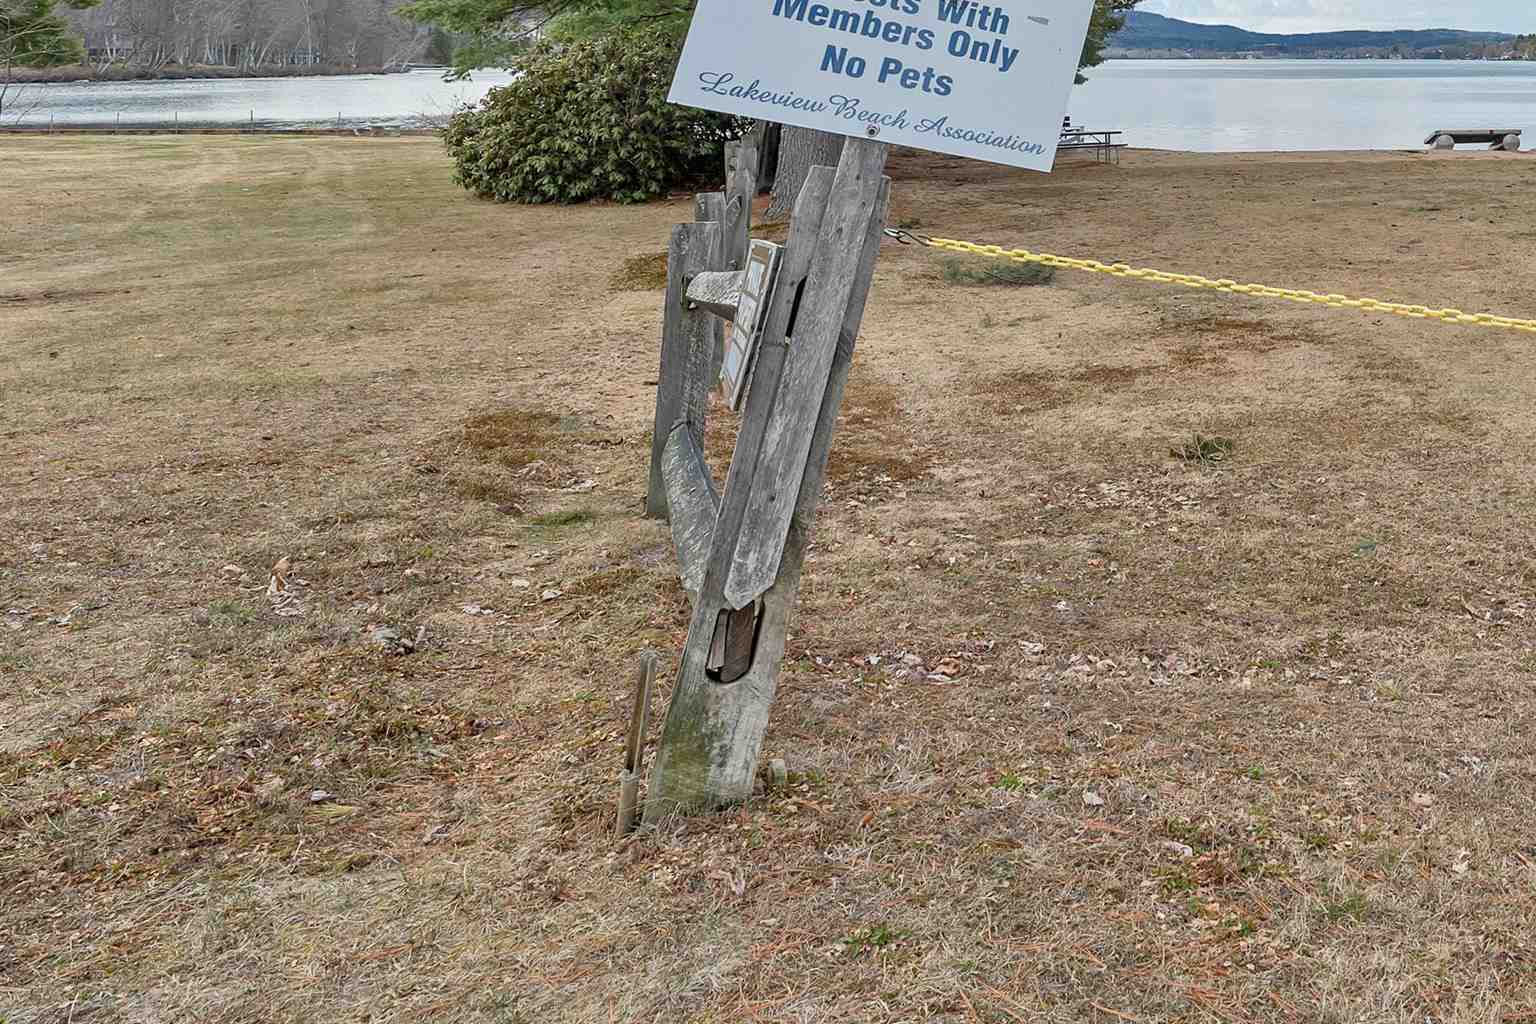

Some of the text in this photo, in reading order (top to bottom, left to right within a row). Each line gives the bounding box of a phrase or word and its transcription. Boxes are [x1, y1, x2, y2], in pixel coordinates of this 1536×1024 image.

[820, 44, 954, 96] No Pets
[948, 30, 1019, 73] Only
[699, 72, 1046, 155] Lakeview Beach Association
